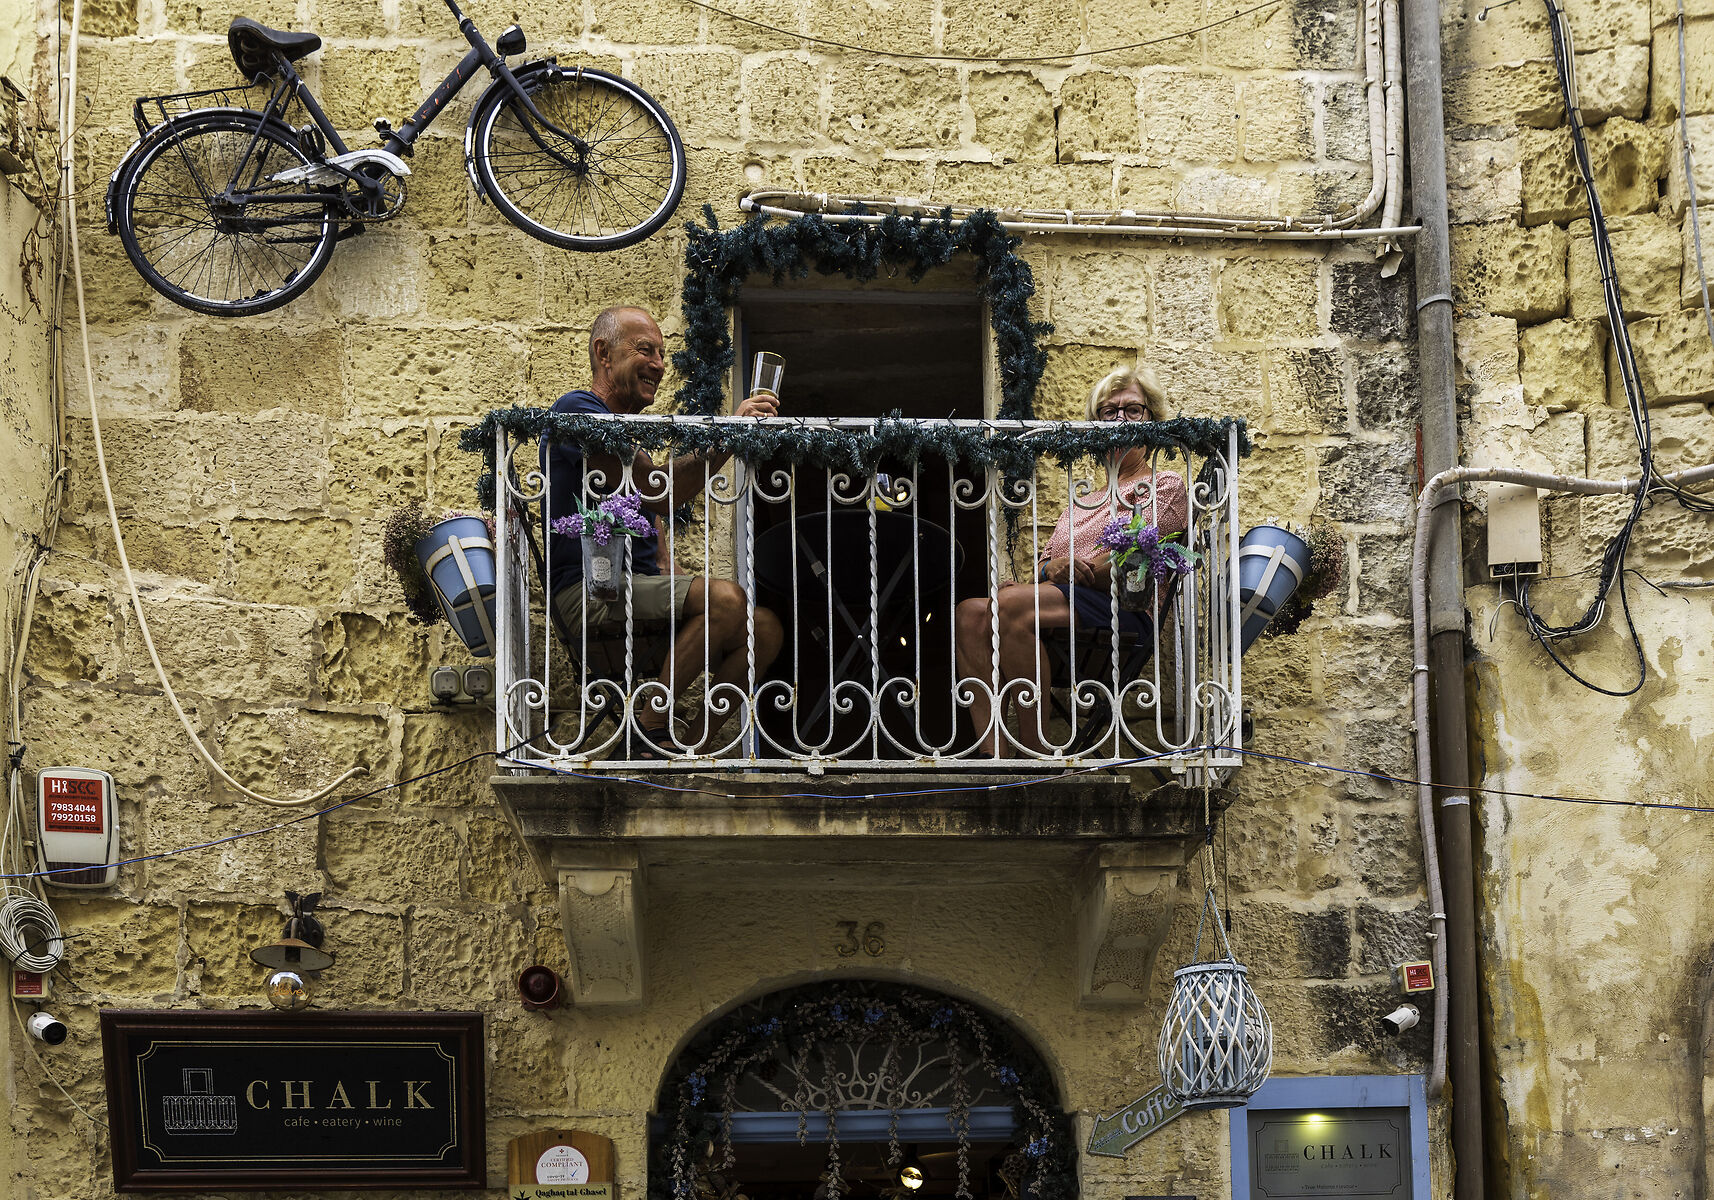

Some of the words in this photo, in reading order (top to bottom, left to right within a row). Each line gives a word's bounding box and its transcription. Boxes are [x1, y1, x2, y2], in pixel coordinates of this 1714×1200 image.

[835, 921, 886, 957] 36
[246, 1080, 435, 1110] CHALK
[284, 1116, 310, 1127] cafe
[322, 1117, 361, 1129] eatery
[373, 1116, 402, 1127] wine
[1303, 1143, 1393, 1160] CHALK
